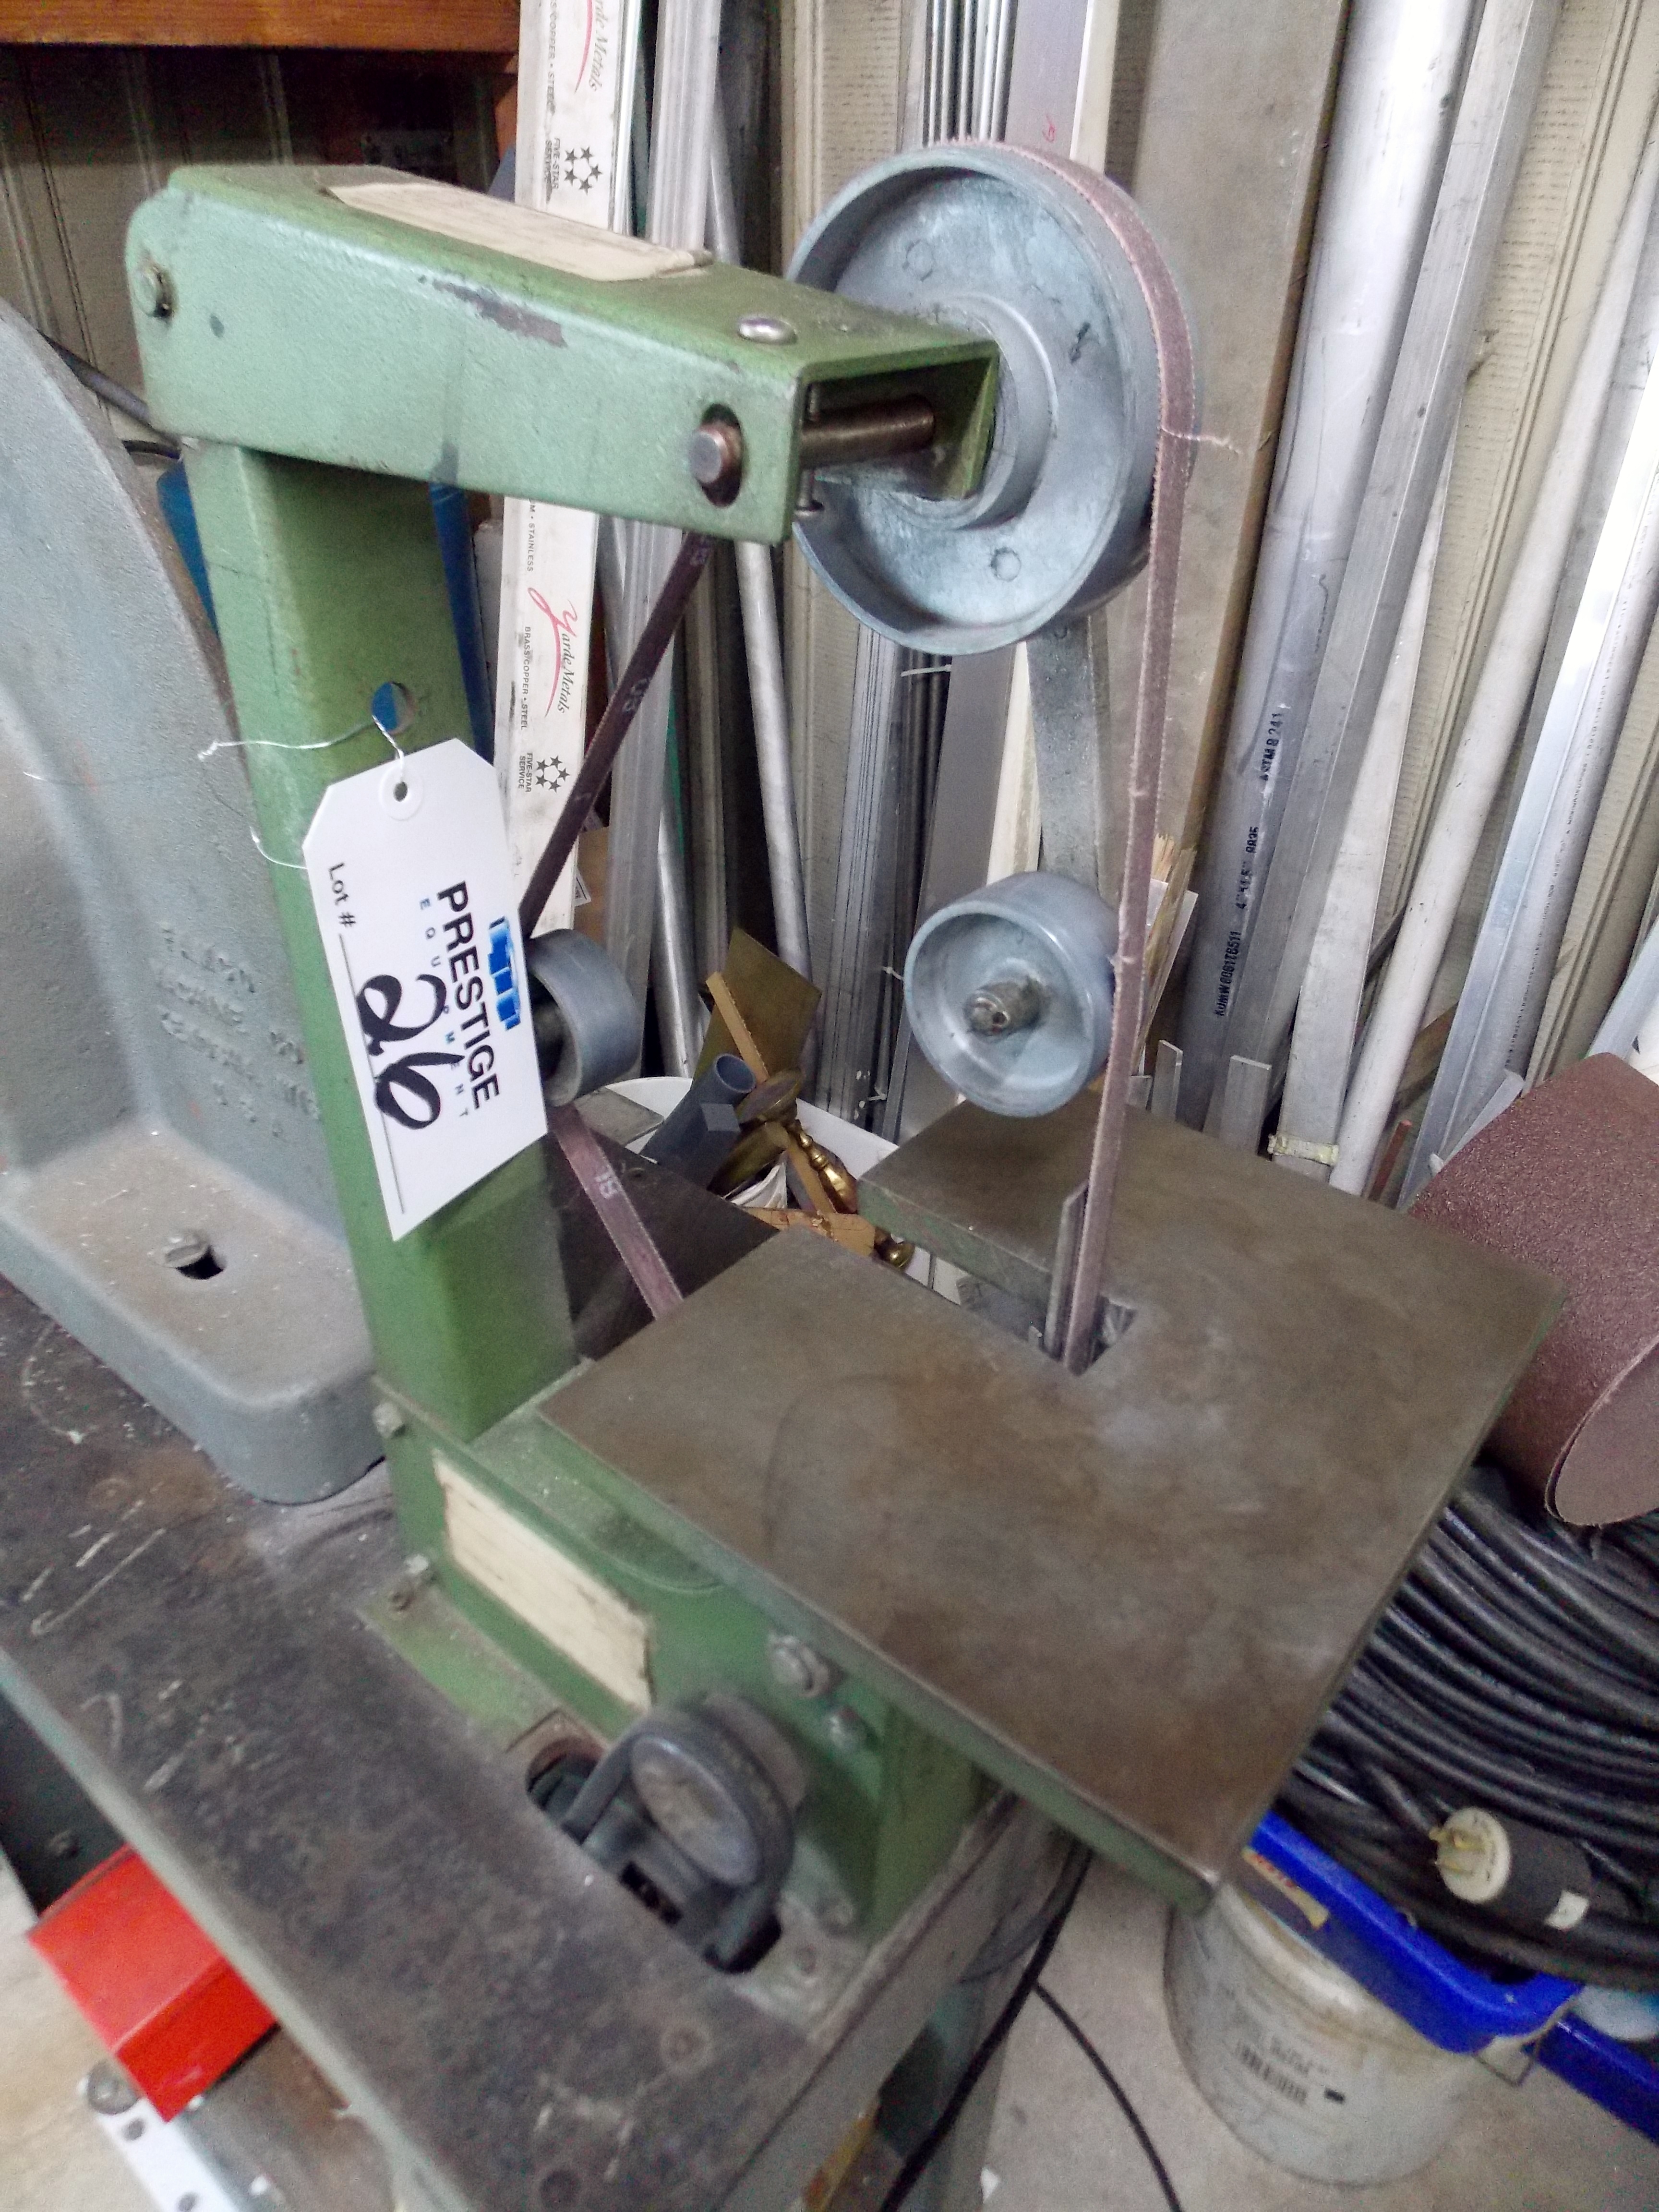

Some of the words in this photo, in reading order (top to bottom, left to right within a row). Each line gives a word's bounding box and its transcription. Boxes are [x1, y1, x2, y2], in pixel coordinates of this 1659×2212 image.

[589, 30, 608, 91] Metals
[552, 138, 560, 190] FIVE-STAR
[522, 626, 531, 695] BRASS/COPPER
[557, 666, 575, 714] Metals
[328, 862, 349, 906] Lot
[419, 898, 469, 1118] EQUPMENT
[437, 880, 500, 1109] PRESTIGE
[355, 973, 465, 1130] 26
